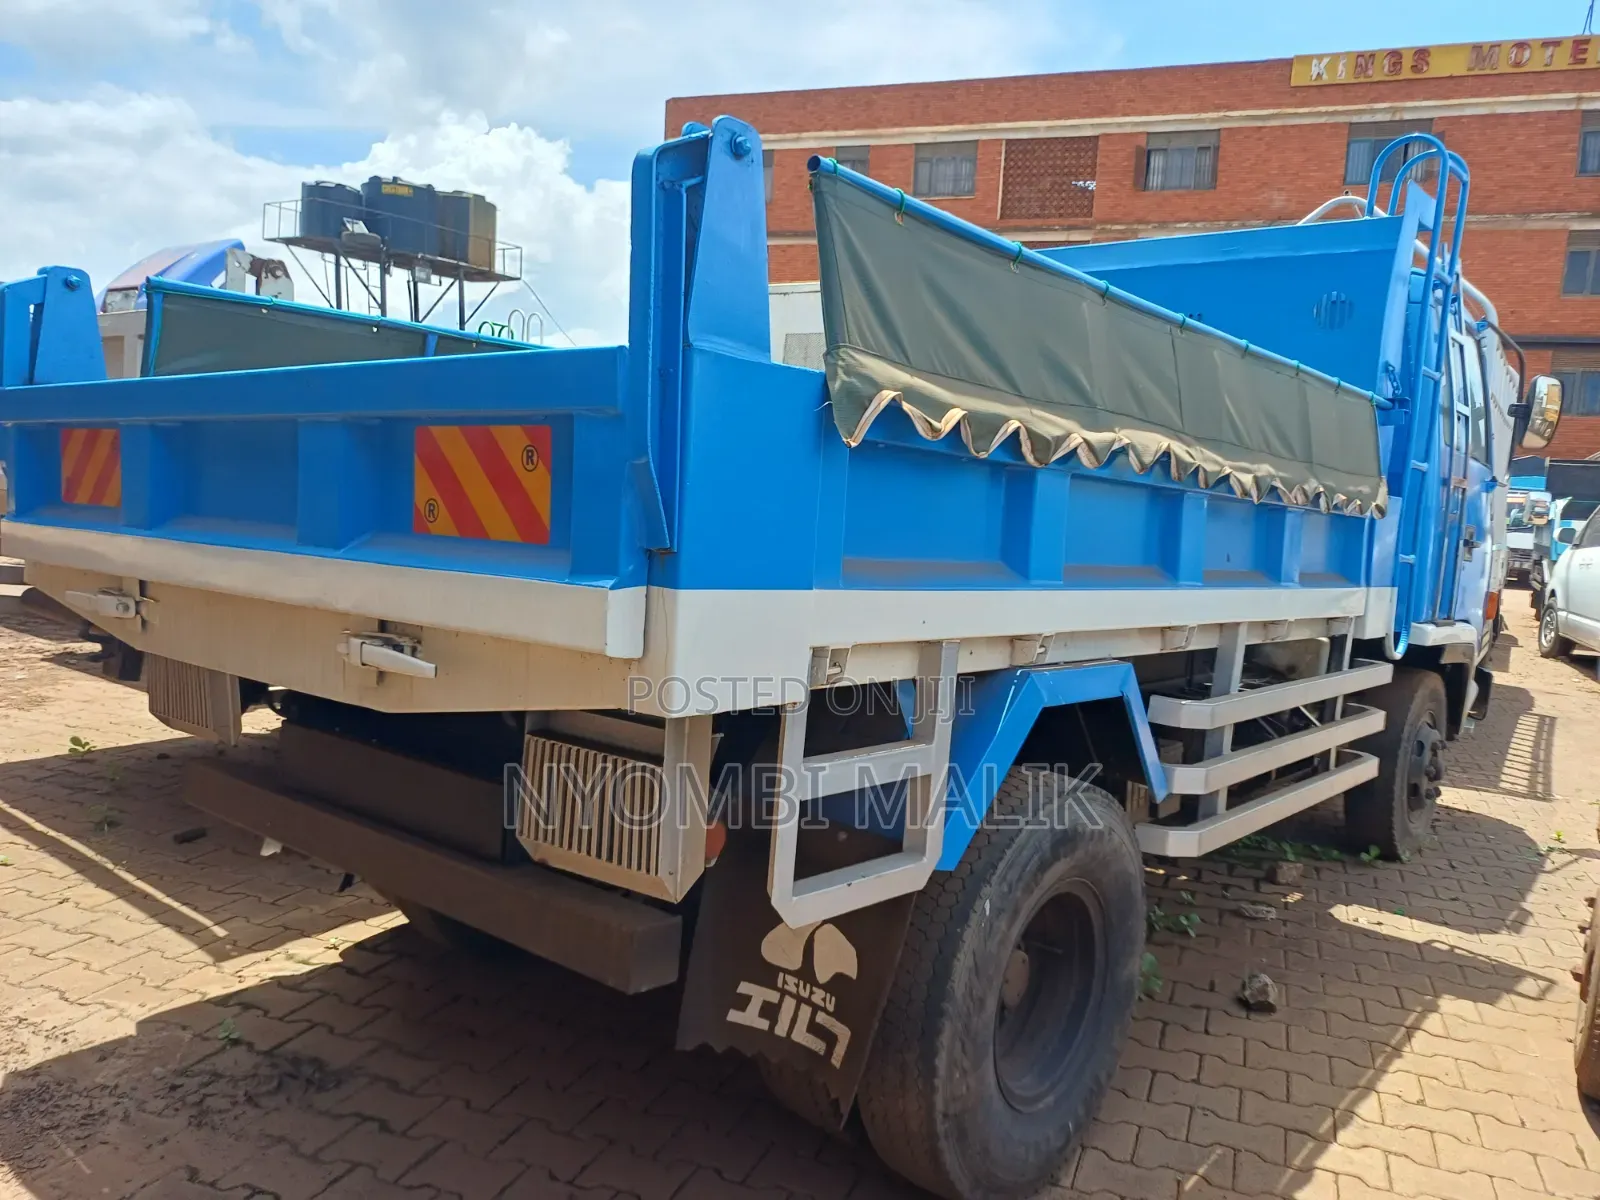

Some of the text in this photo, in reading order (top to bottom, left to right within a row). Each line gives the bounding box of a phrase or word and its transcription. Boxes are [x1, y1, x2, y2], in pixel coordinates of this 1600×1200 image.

[1310, 38, 1600, 81] KINGS MOTE
[777, 971, 836, 1013] ISUZU
